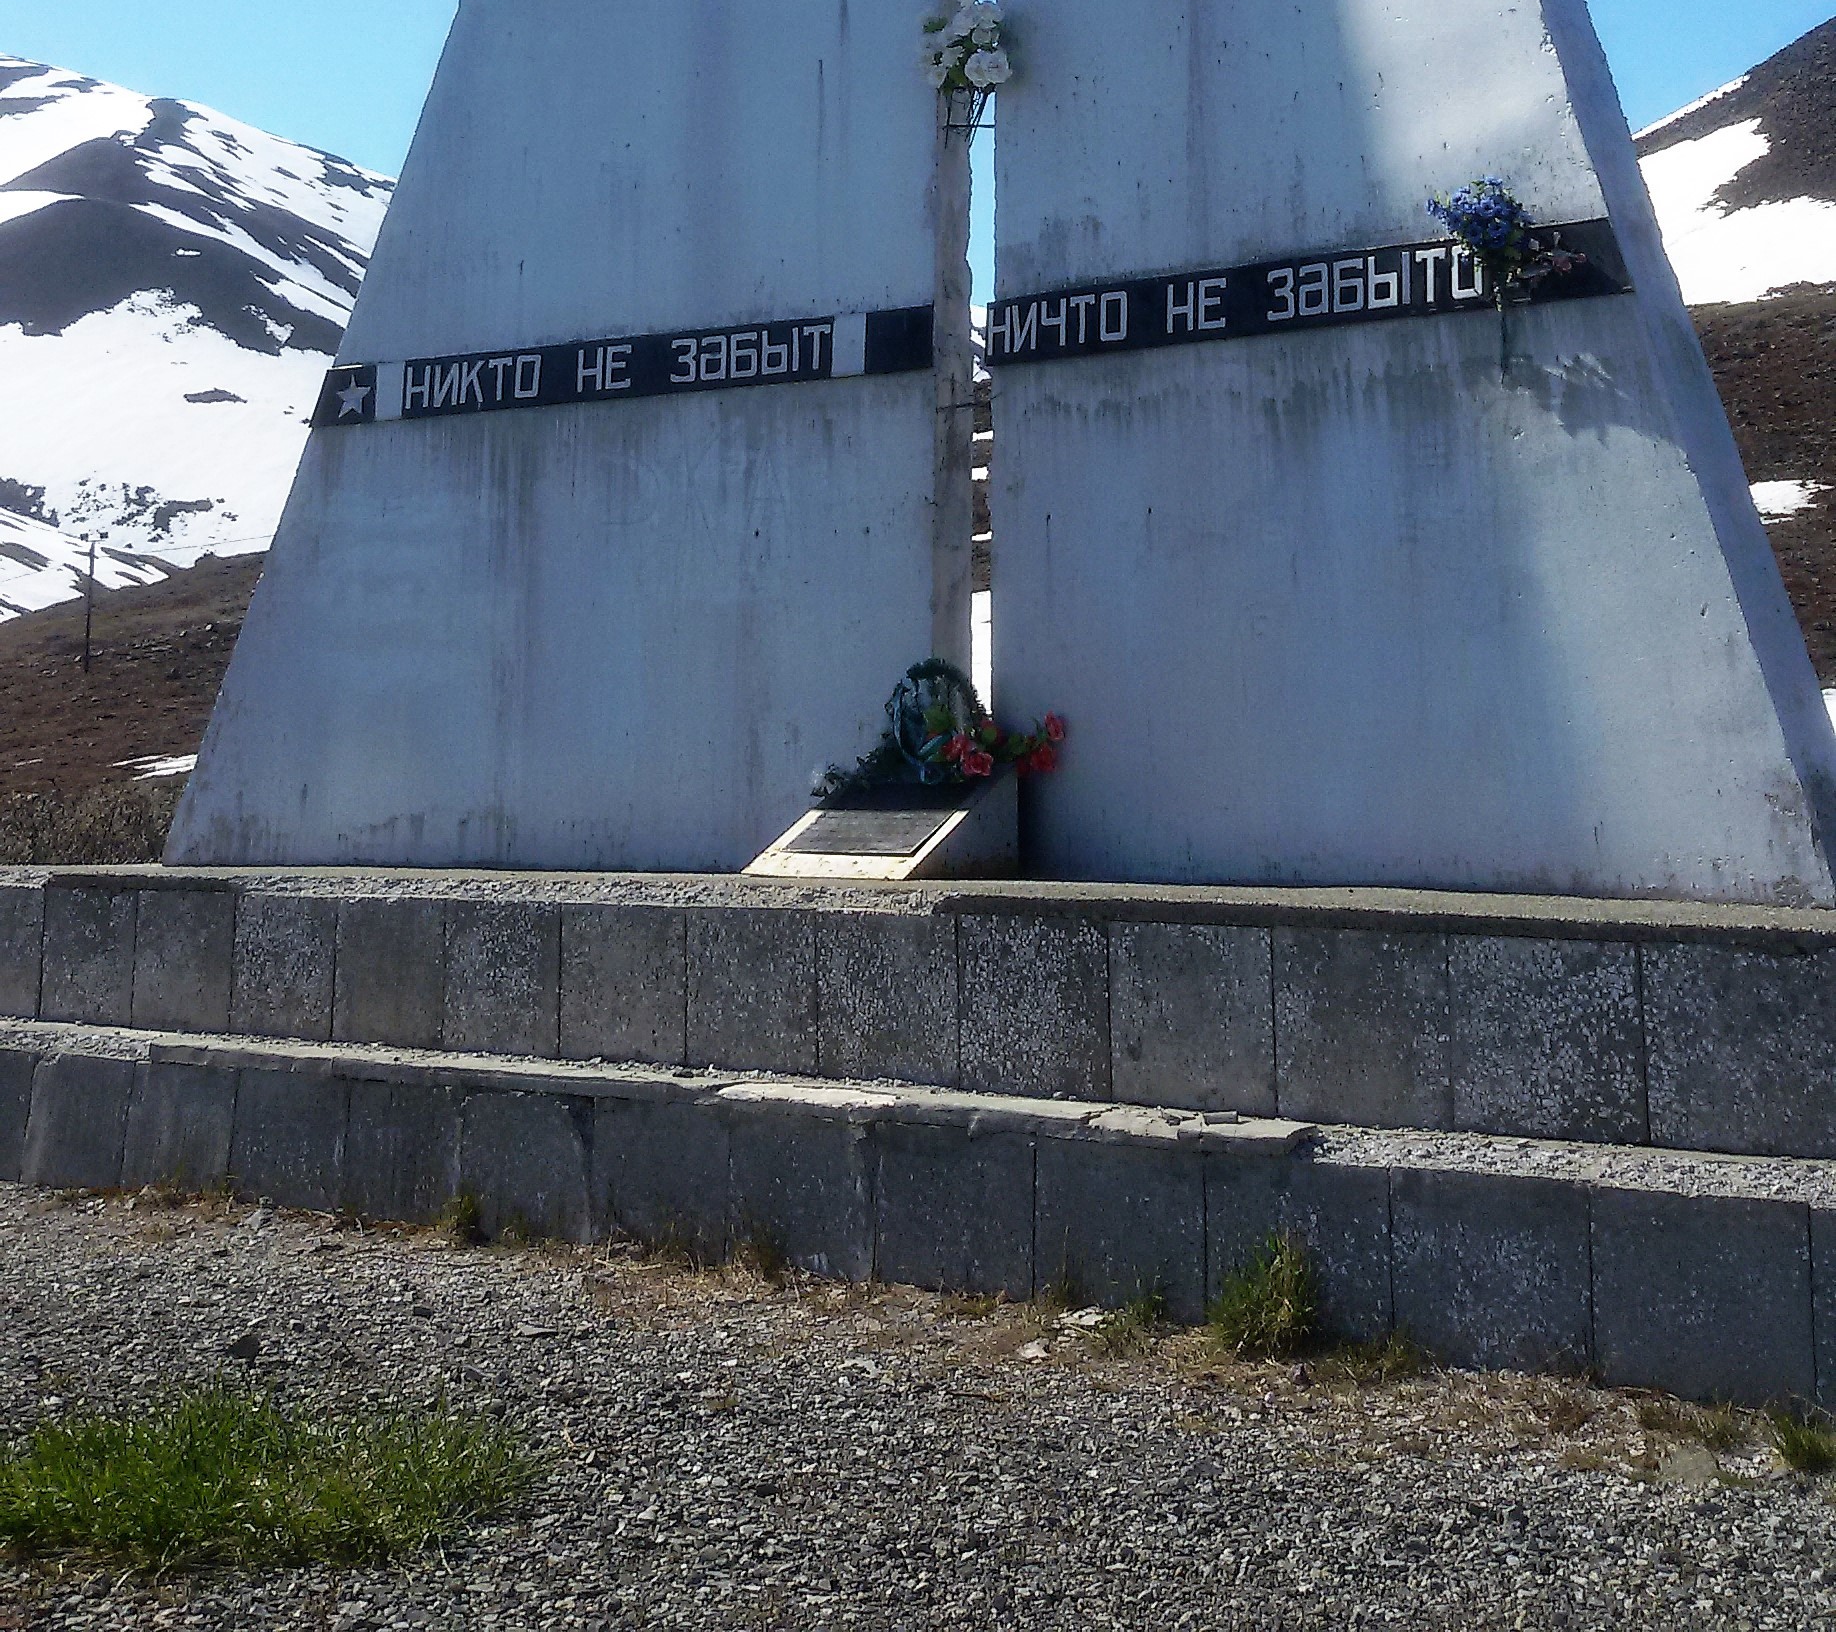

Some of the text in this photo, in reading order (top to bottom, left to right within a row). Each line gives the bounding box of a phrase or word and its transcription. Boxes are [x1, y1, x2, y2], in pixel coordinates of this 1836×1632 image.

[987, 291, 1128, 356] НИЧТО
[1166, 278, 1227, 334] НЕ
[404, 354, 542, 410] НИКТО
[576, 344, 633, 393] НЕ
